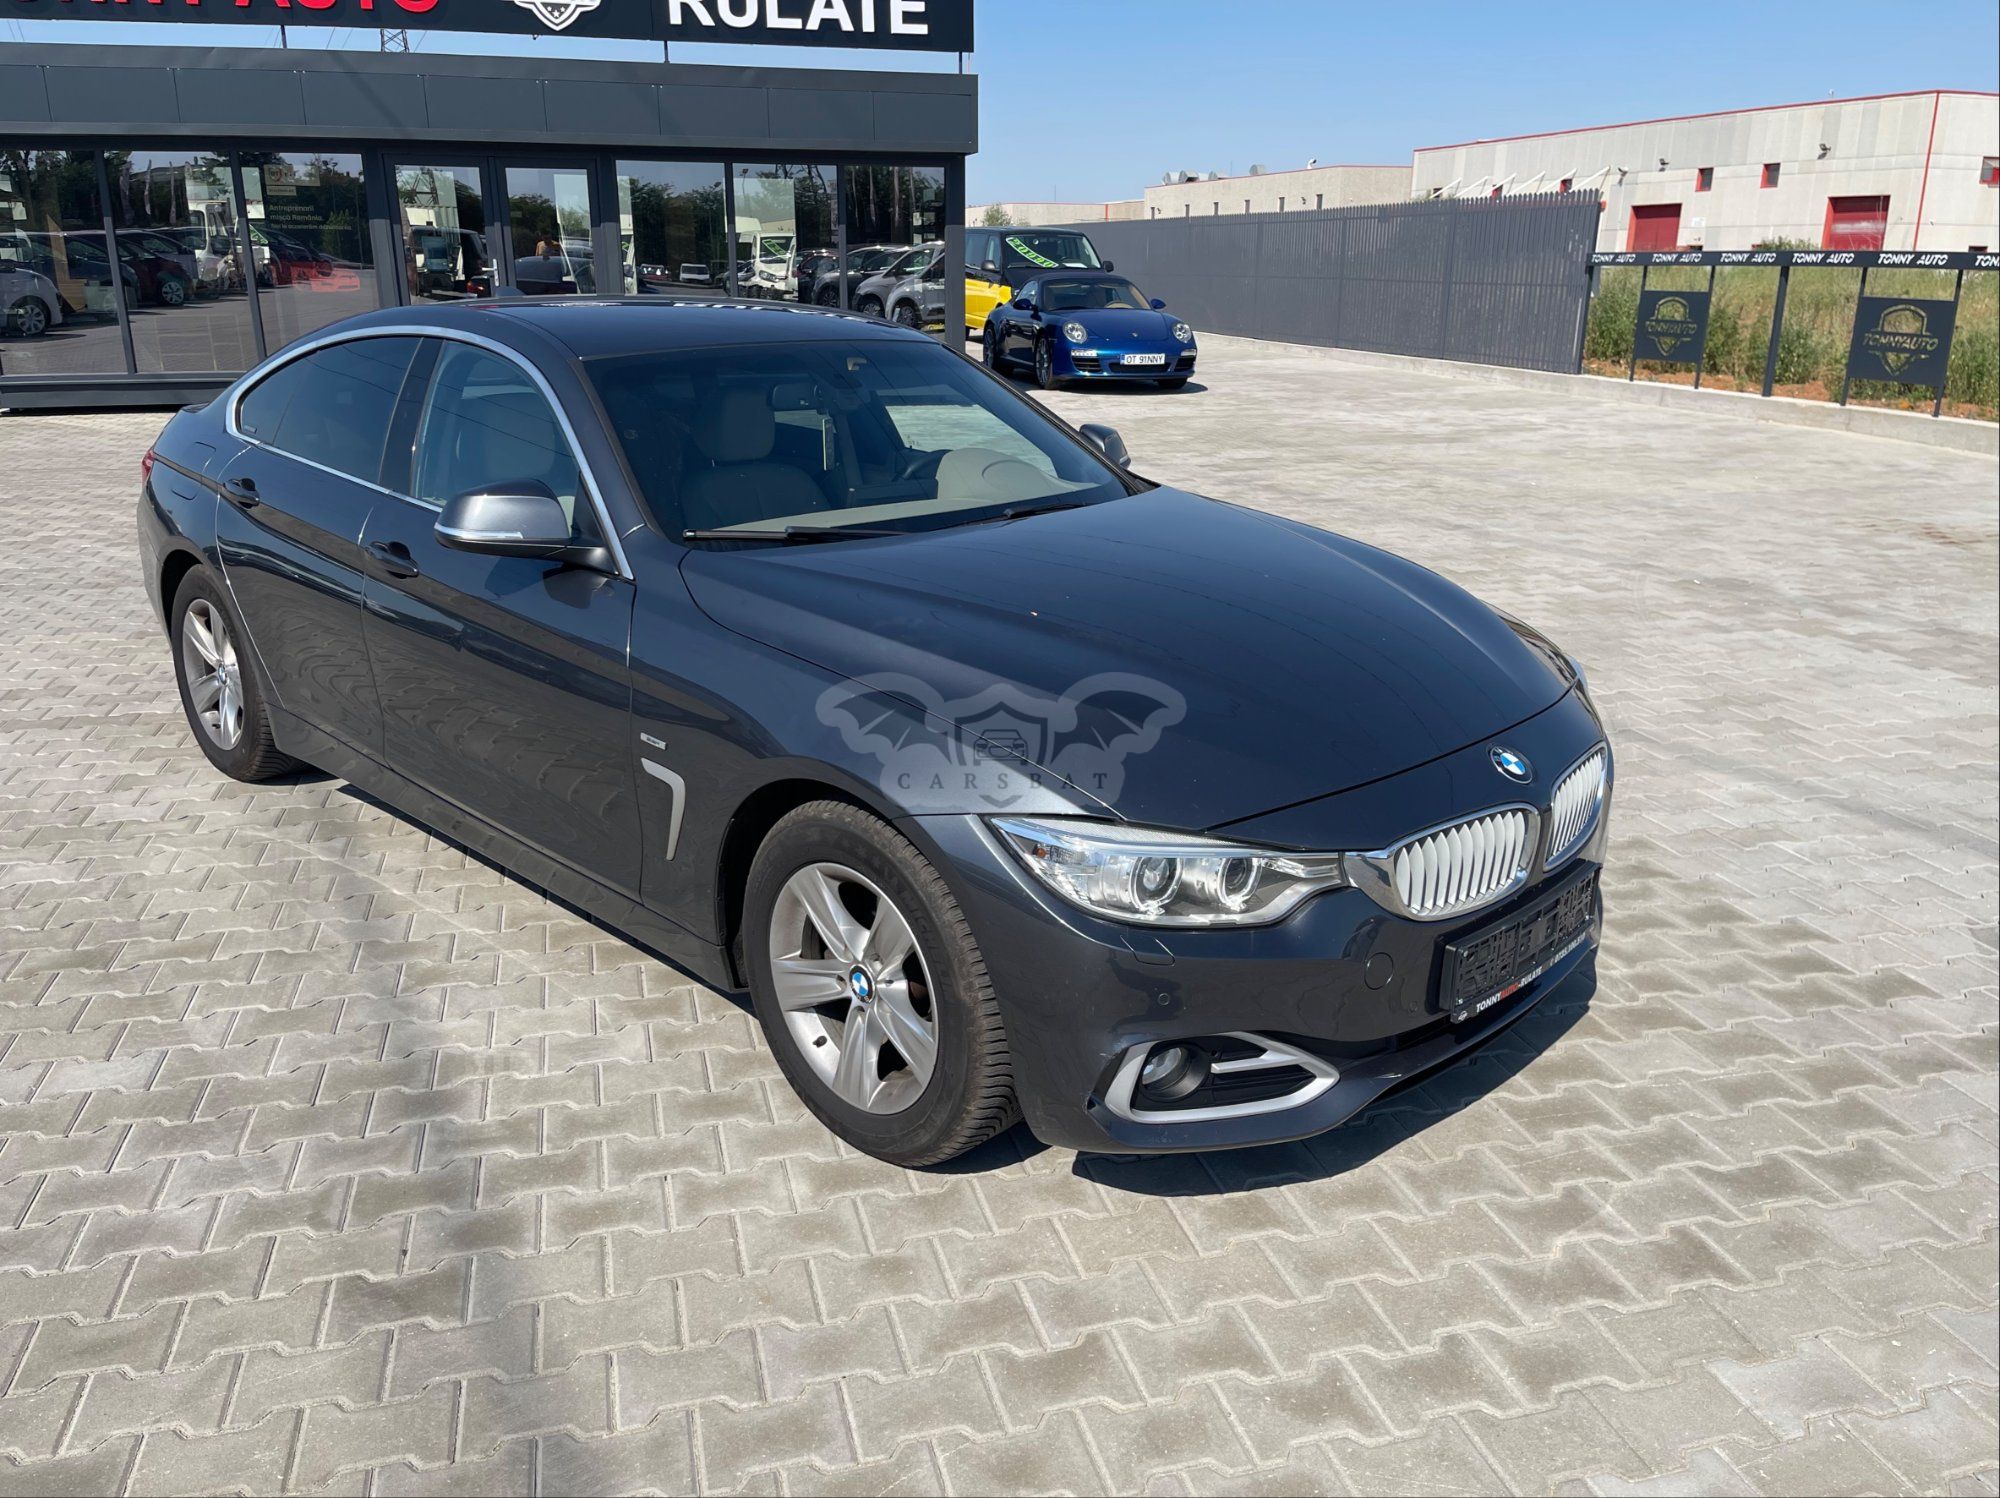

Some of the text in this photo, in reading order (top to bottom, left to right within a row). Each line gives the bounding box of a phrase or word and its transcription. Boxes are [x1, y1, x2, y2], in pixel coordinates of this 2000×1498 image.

[1591, 254, 1636, 263] TONNY AUTO
[1652, 253, 1702, 263] TONNY AUTO
[1720, 253, 1776, 263] TONNY AUTO
[1792, 253, 1854, 264] TONNY AUTO
[1878, 254, 1948, 265] TONNY AUTO
[1863, 332, 1939, 351] TONNYAUTO
